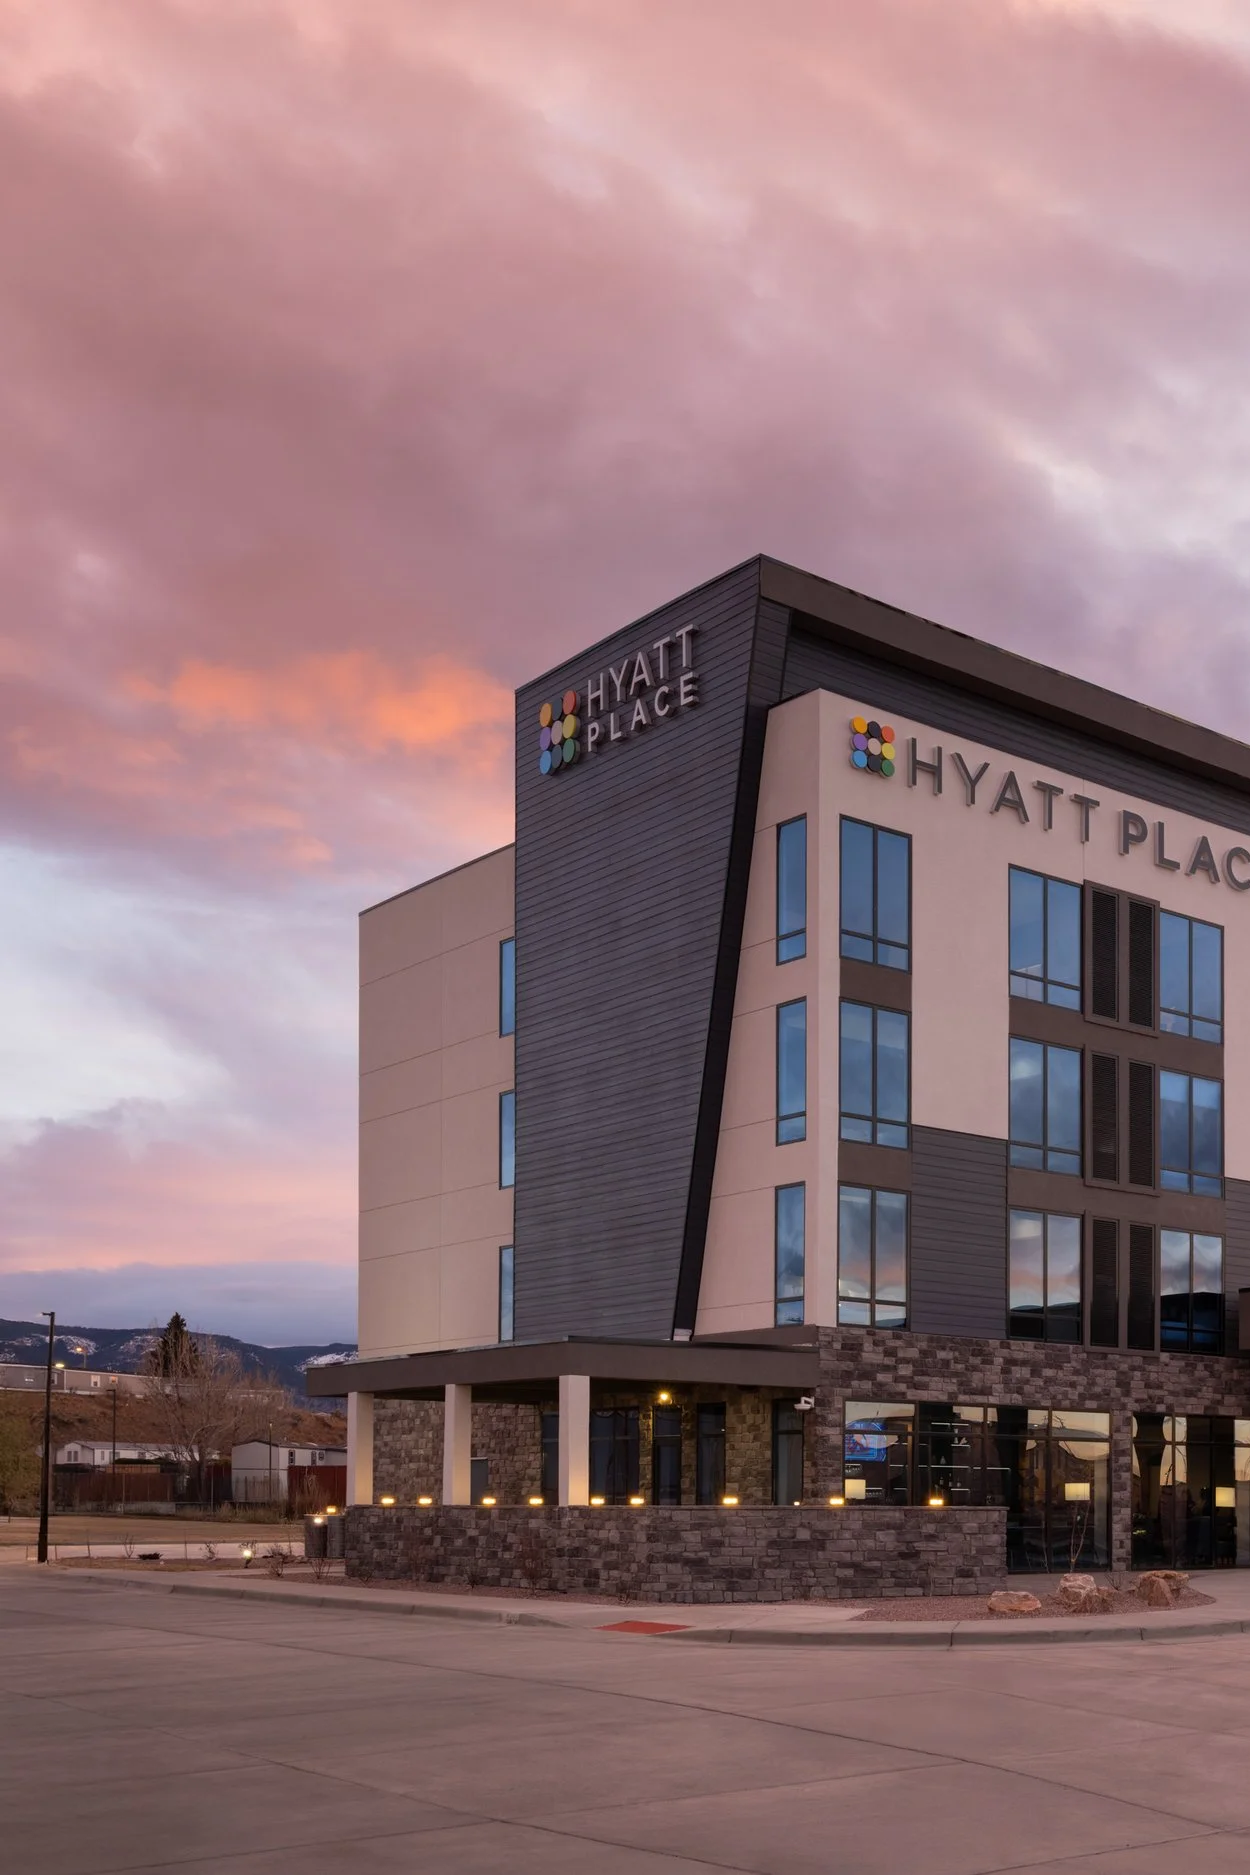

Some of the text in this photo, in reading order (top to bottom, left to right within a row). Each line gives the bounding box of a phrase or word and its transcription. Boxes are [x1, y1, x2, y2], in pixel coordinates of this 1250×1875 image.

[587, 624, 697, 718] HYATT
[587, 672, 698, 752] PLACE
[908, 737, 1100, 844] HYATT
